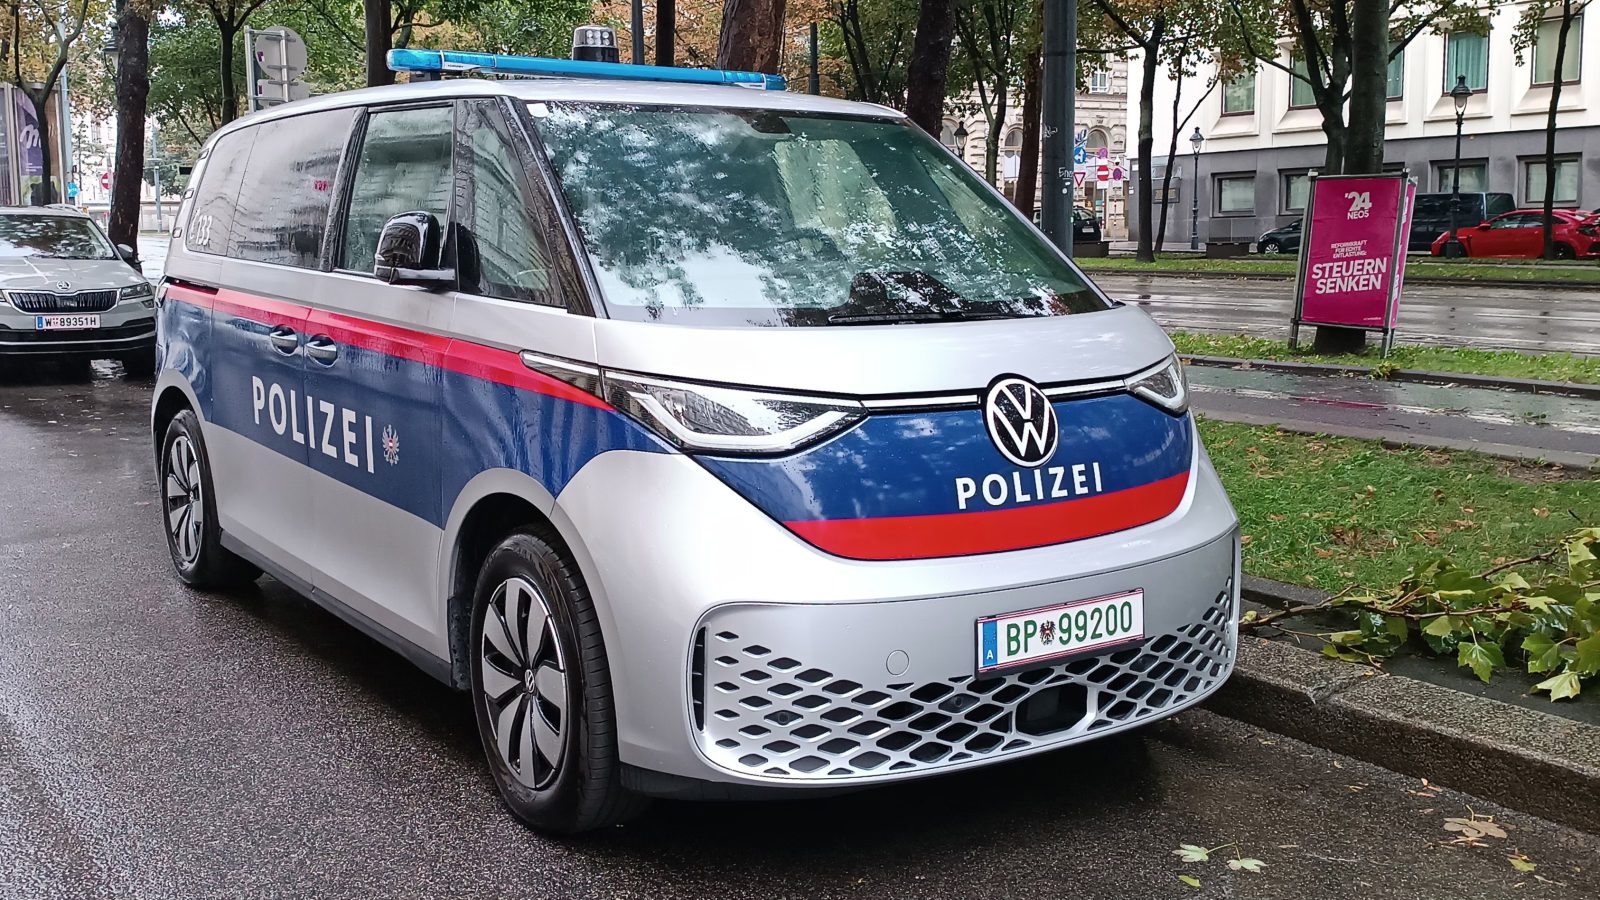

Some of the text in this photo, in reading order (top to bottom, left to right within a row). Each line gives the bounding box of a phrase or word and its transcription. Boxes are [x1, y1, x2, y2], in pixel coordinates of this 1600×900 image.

[1347, 210, 1370, 220] NEOS
[196, 214, 212, 246] 133
[1312, 257, 1387, 279] STEUERN
[1315, 274, 1382, 294] SENKEN
[44, 317, 52, 327] W
[252, 375, 375, 474] POLIZEI
[955, 462, 1103, 510] POLIZEI
[1006, 600, 1133, 657] BP 99200
[986, 649, 995, 660] A
